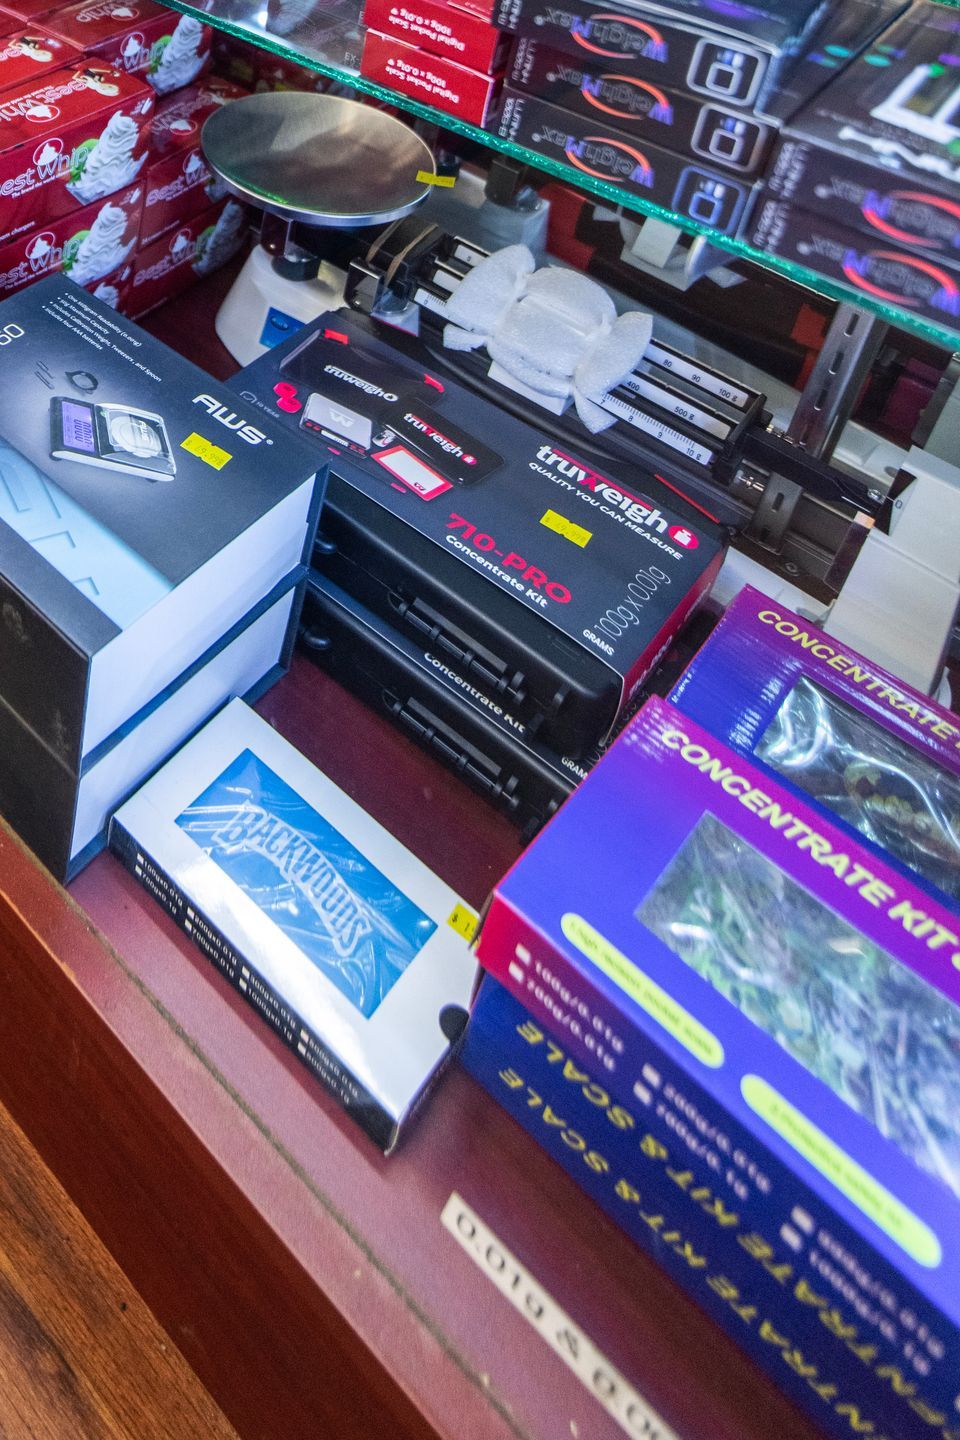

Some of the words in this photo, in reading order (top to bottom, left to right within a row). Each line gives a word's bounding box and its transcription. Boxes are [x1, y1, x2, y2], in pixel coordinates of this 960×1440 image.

[388, 15, 410, 30] Scale
[399, 7, 423, 24] 0.01g
[431, 19, 452, 36] 100g
[410, 23, 437, 40] Pocket
[437, 32, 466, 51] Digital
[545, 8, 669, 64] WeighMax
[385, 65, 406, 80] Scale
[396, 59, 420, 76] 0.01g
[406, 74, 433, 92] Pocket
[426, 71, 447, 88] 100g
[432, 83, 460, 104] Digital
[37, 147, 88, 179] Whip
[29, 240, 81, 271] Whip
[44, 307, 64, 323] Includes
[62, 320, 73, 329] four
[72, 326, 83, 337] AAA
[81, 334, 104, 351] batteries
[67, 294, 79, 303] One
[97, 314, 122, 334] Readability
[68, 304, 92, 322] Maximum
[89, 319, 110, 335] Capacity
[52, 303, 71, 318] Includes
[70, 315, 95, 334] Calibration
[134, 362, 147, 372] and
[144, 367, 163, 383] Spoon
[662, 359, 673, 368] 80
[691, 374, 702, 383] 90
[323, 364, 384, 396] truweigh
[627, 380, 640, 391] 400
[718, 387, 732, 399] 100
[192, 393, 268, 446] AWS
[674, 406, 689, 418] 500
[403, 412, 463, 458] truweigh
[686, 447, 695, 458] 10
[535, 444, 669, 534] truweigh
[528, 461, 576, 491] QUALITY
[575, 489, 601, 507] YOU
[599, 503, 626, 523] CAN
[624, 519, 684, 561] MEASURE
[445, 534, 525, 592] Concentrate
[525, 588, 549, 608] Kit
[446, 512, 572, 604] 710-PRO
[592, 603, 641, 642] 100g
[628, 565, 672, 602] 0.01g
[582, 628, 615, 656] GRAMS
[758, 609, 957, 742] CONCENTRATE
[423, 651, 504, 721] Concentrate
[503, 711, 527, 733] Kit
[660, 727, 895, 909] CONCENTRATE
[888, 899, 959, 952] KIT
[516, 1020, 637, 1131] SCALE
[666, 1164, 740, 1228] KIT
[498, 1067, 610, 1175] SCALE
[640, 1207, 707, 1269] KIT
[456, 1209, 546, 1324] 0.01g
[555, 1325, 582, 1361] &
